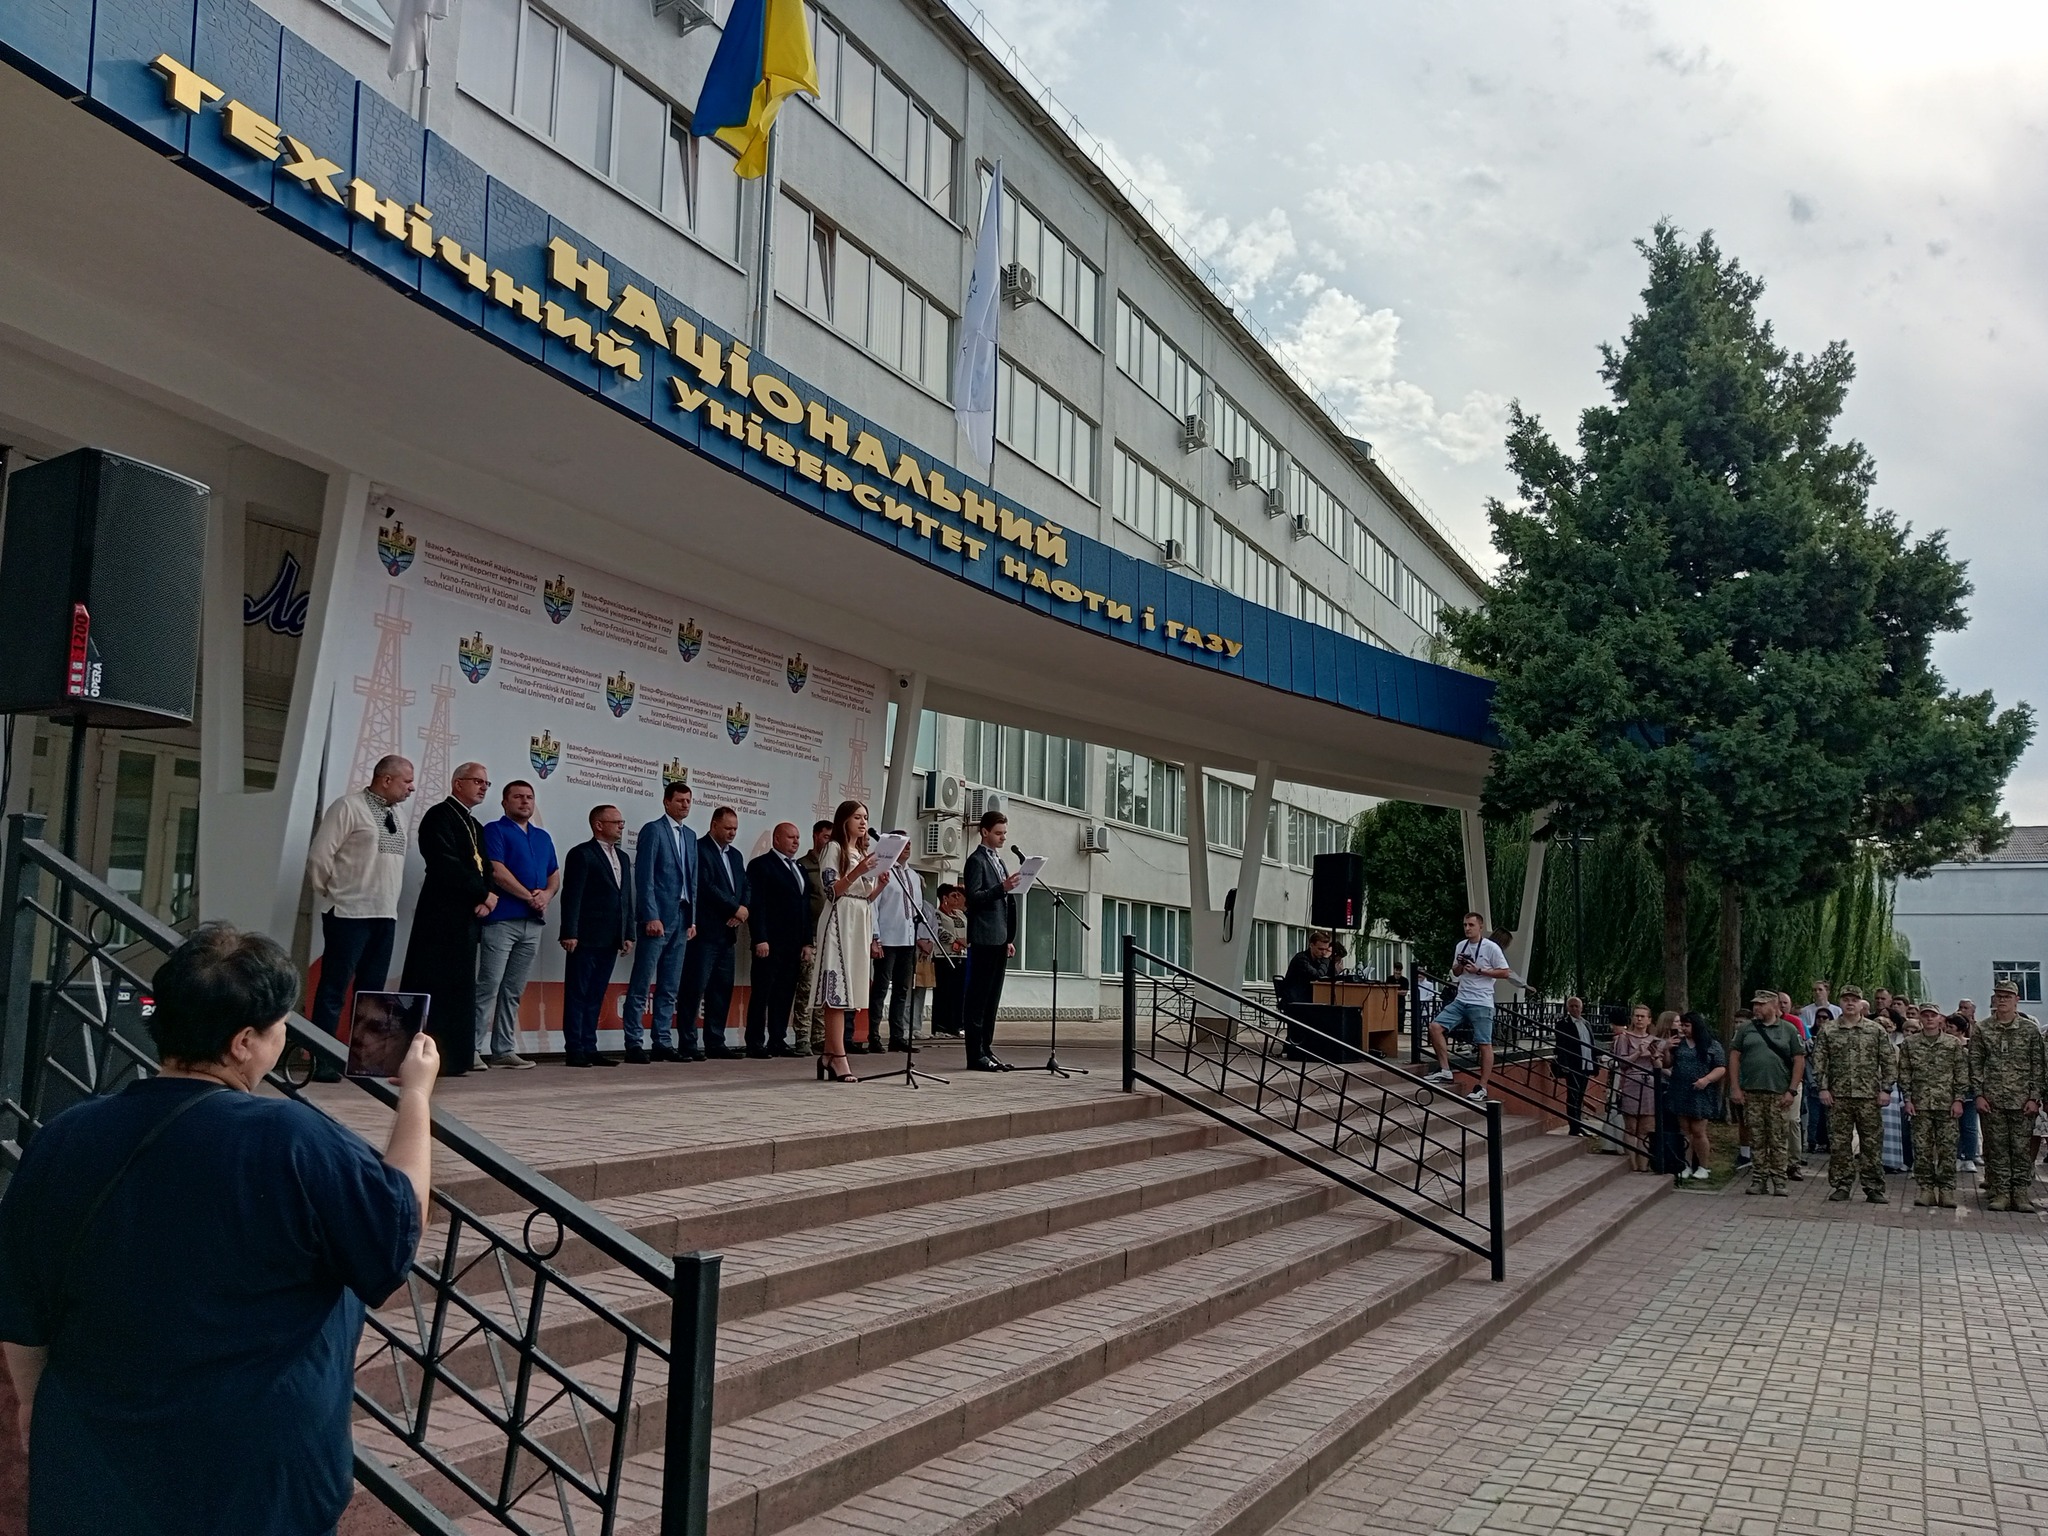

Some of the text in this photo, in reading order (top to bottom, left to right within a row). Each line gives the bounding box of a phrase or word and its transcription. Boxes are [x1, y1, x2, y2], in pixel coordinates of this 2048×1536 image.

[488, 596, 496, 604] of
[496, 598, 506, 607] Oil
[506, 602, 518, 611] and
[519, 604, 531, 614] Gas
[491, 587, 518, 601] National
[1001, 555, 1133, 624] НАФТИ
[1165, 619, 1243, 658] ГАЗУ
[73, 614, 88, 651] 1200
[90, 662, 102, 698] OPERA
